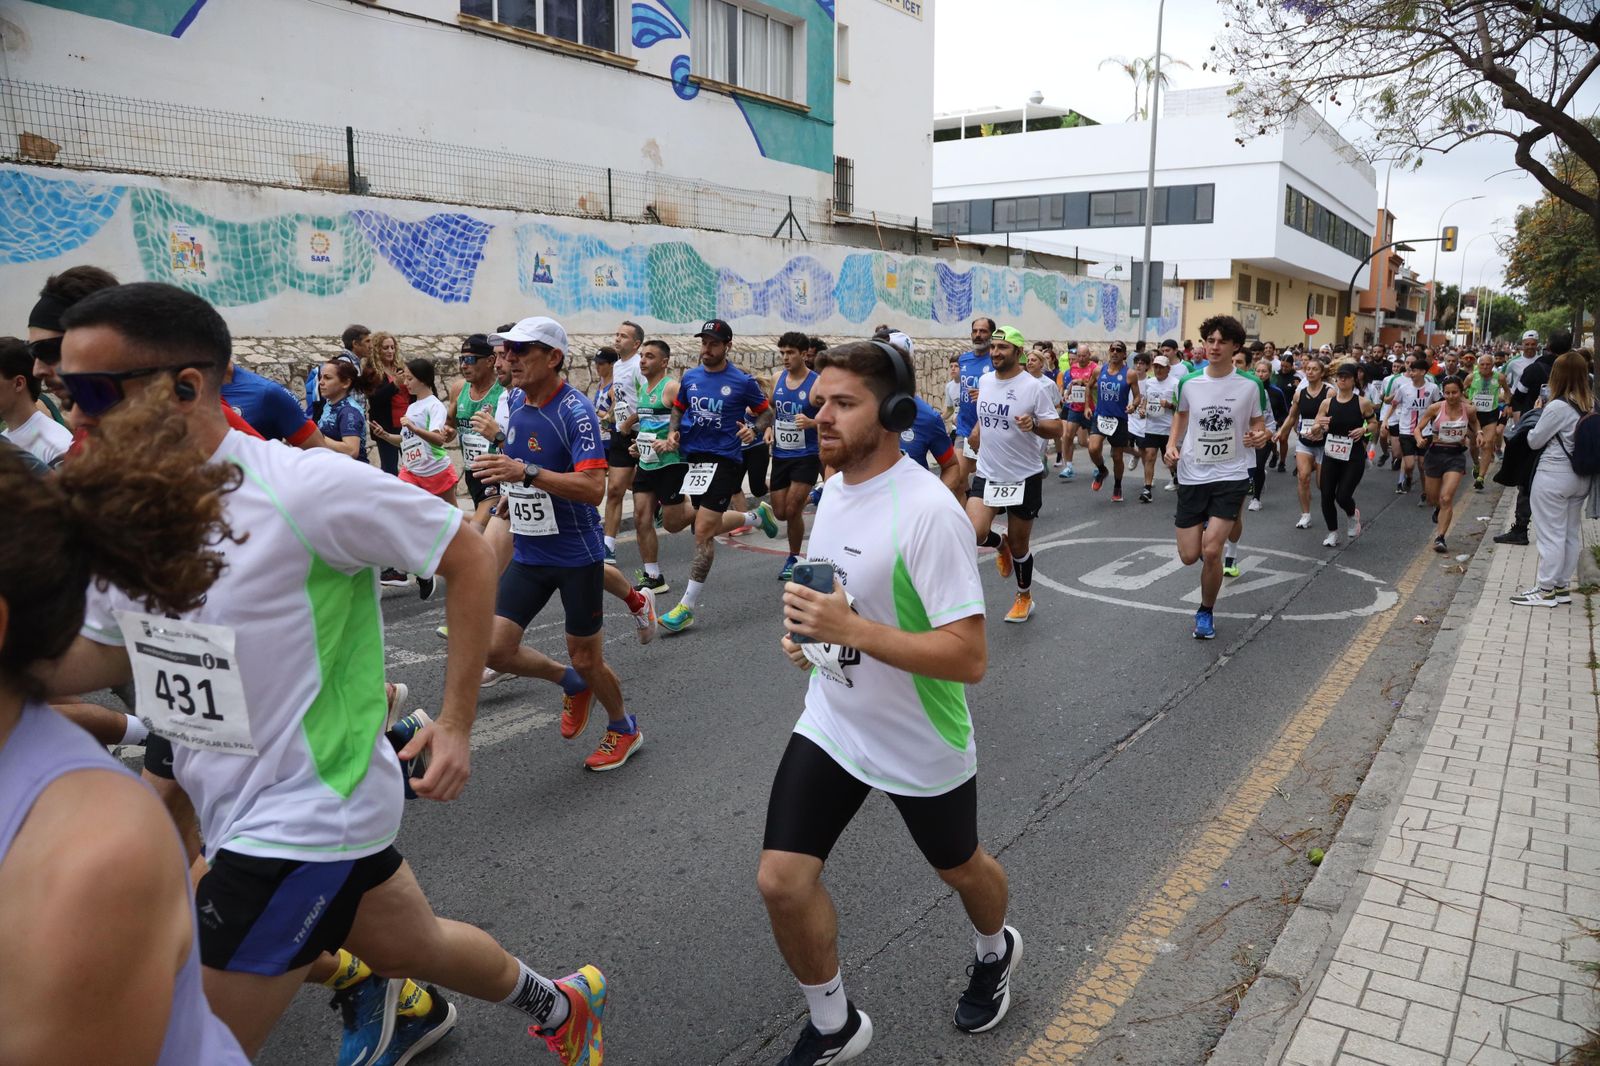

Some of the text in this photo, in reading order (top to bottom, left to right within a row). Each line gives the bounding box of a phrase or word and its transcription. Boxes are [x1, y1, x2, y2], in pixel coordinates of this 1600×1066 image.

[1100, 381, 1121, 391] RCM
[690, 396, 723, 413] RCM
[775, 400, 803, 415] RCM
[980, 401, 1010, 416] RCM
[692, 415, 722, 429] 1873
[979, 416, 1010, 430] 1873
[1100, 421, 1114, 430] 655
[780, 432, 800, 443] 602
[406, 448, 422, 462] 264
[1202, 443, 1229, 456] 702
[1331, 444, 1348, 454] 124
[689, 475, 708, 487] 735
[992, 486, 1018, 498] 787
[514, 502, 545, 522] 455
[155, 669, 224, 722] 431
